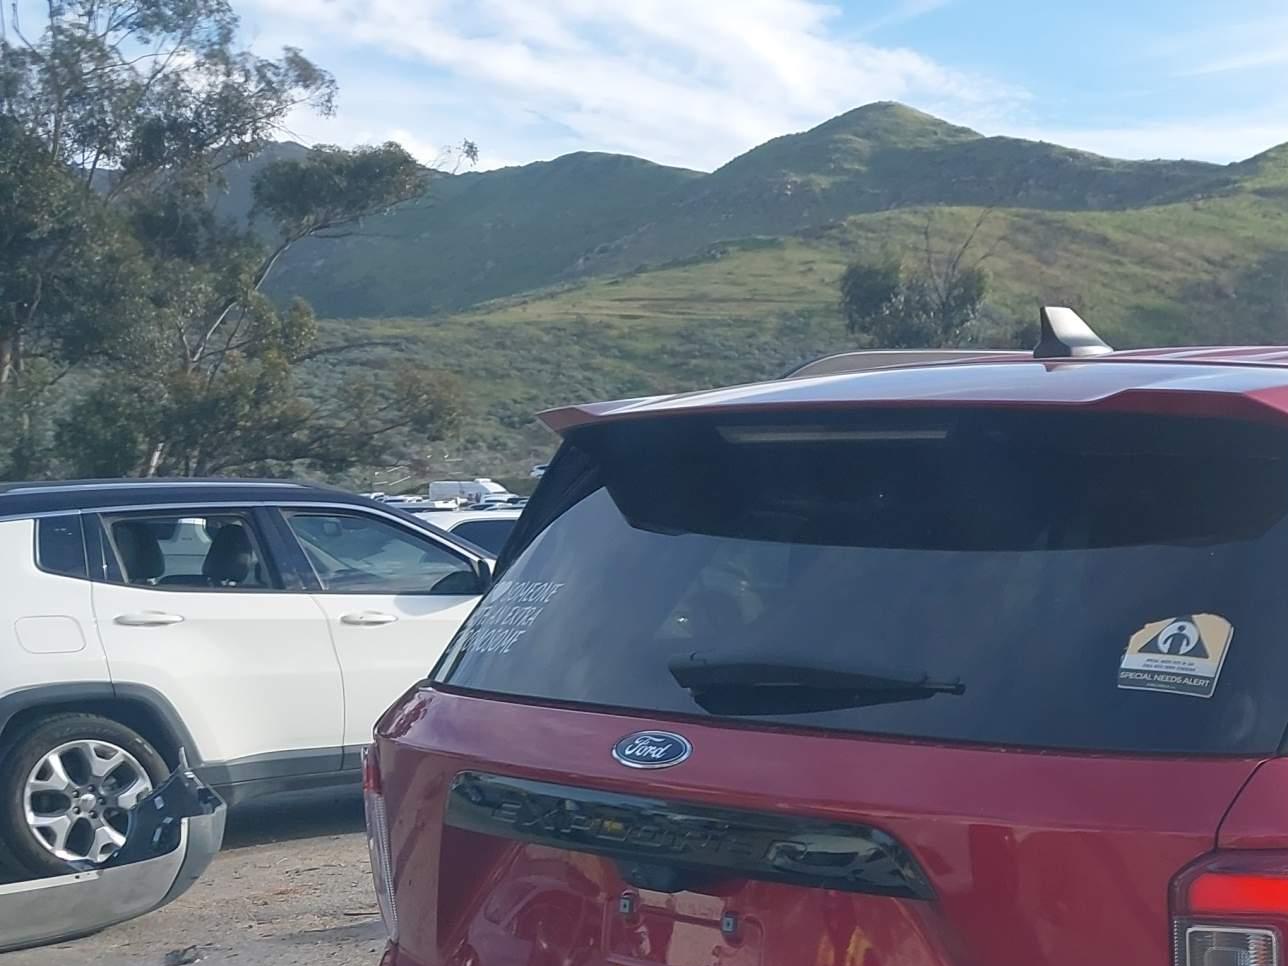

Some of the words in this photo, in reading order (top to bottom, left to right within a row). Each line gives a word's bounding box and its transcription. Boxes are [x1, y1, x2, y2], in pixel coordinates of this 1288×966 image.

[504, 581, 565, 603] SOMEONE
[501, 606, 544, 626] EXTRA
[1119, 671, 1153, 681] SPECIAL
[1153, 674, 1182, 684] NEEDS
[1183, 677, 1211, 687] ALERT
[624, 735, 673, 759] Ford
